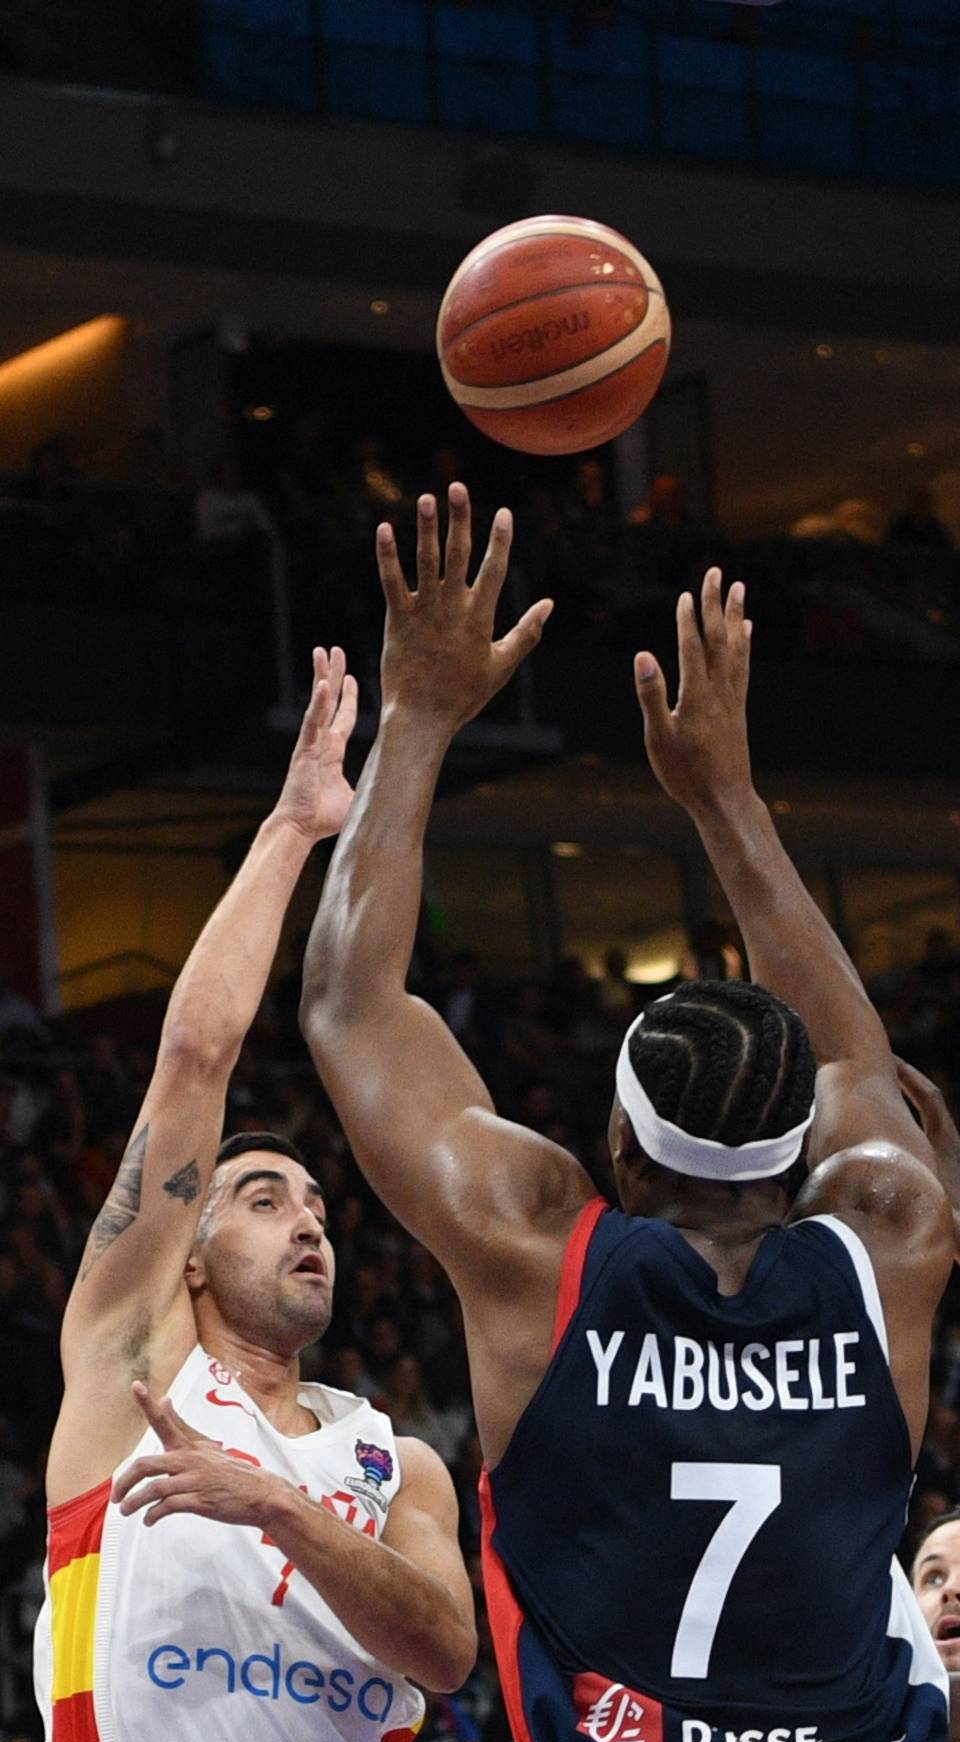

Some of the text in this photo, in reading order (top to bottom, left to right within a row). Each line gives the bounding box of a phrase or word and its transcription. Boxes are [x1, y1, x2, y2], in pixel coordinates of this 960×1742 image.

[585, 1329, 867, 1411] YABUSELE
[670, 1461, 782, 1680] 7
[147, 1642, 394, 1723] endesa
